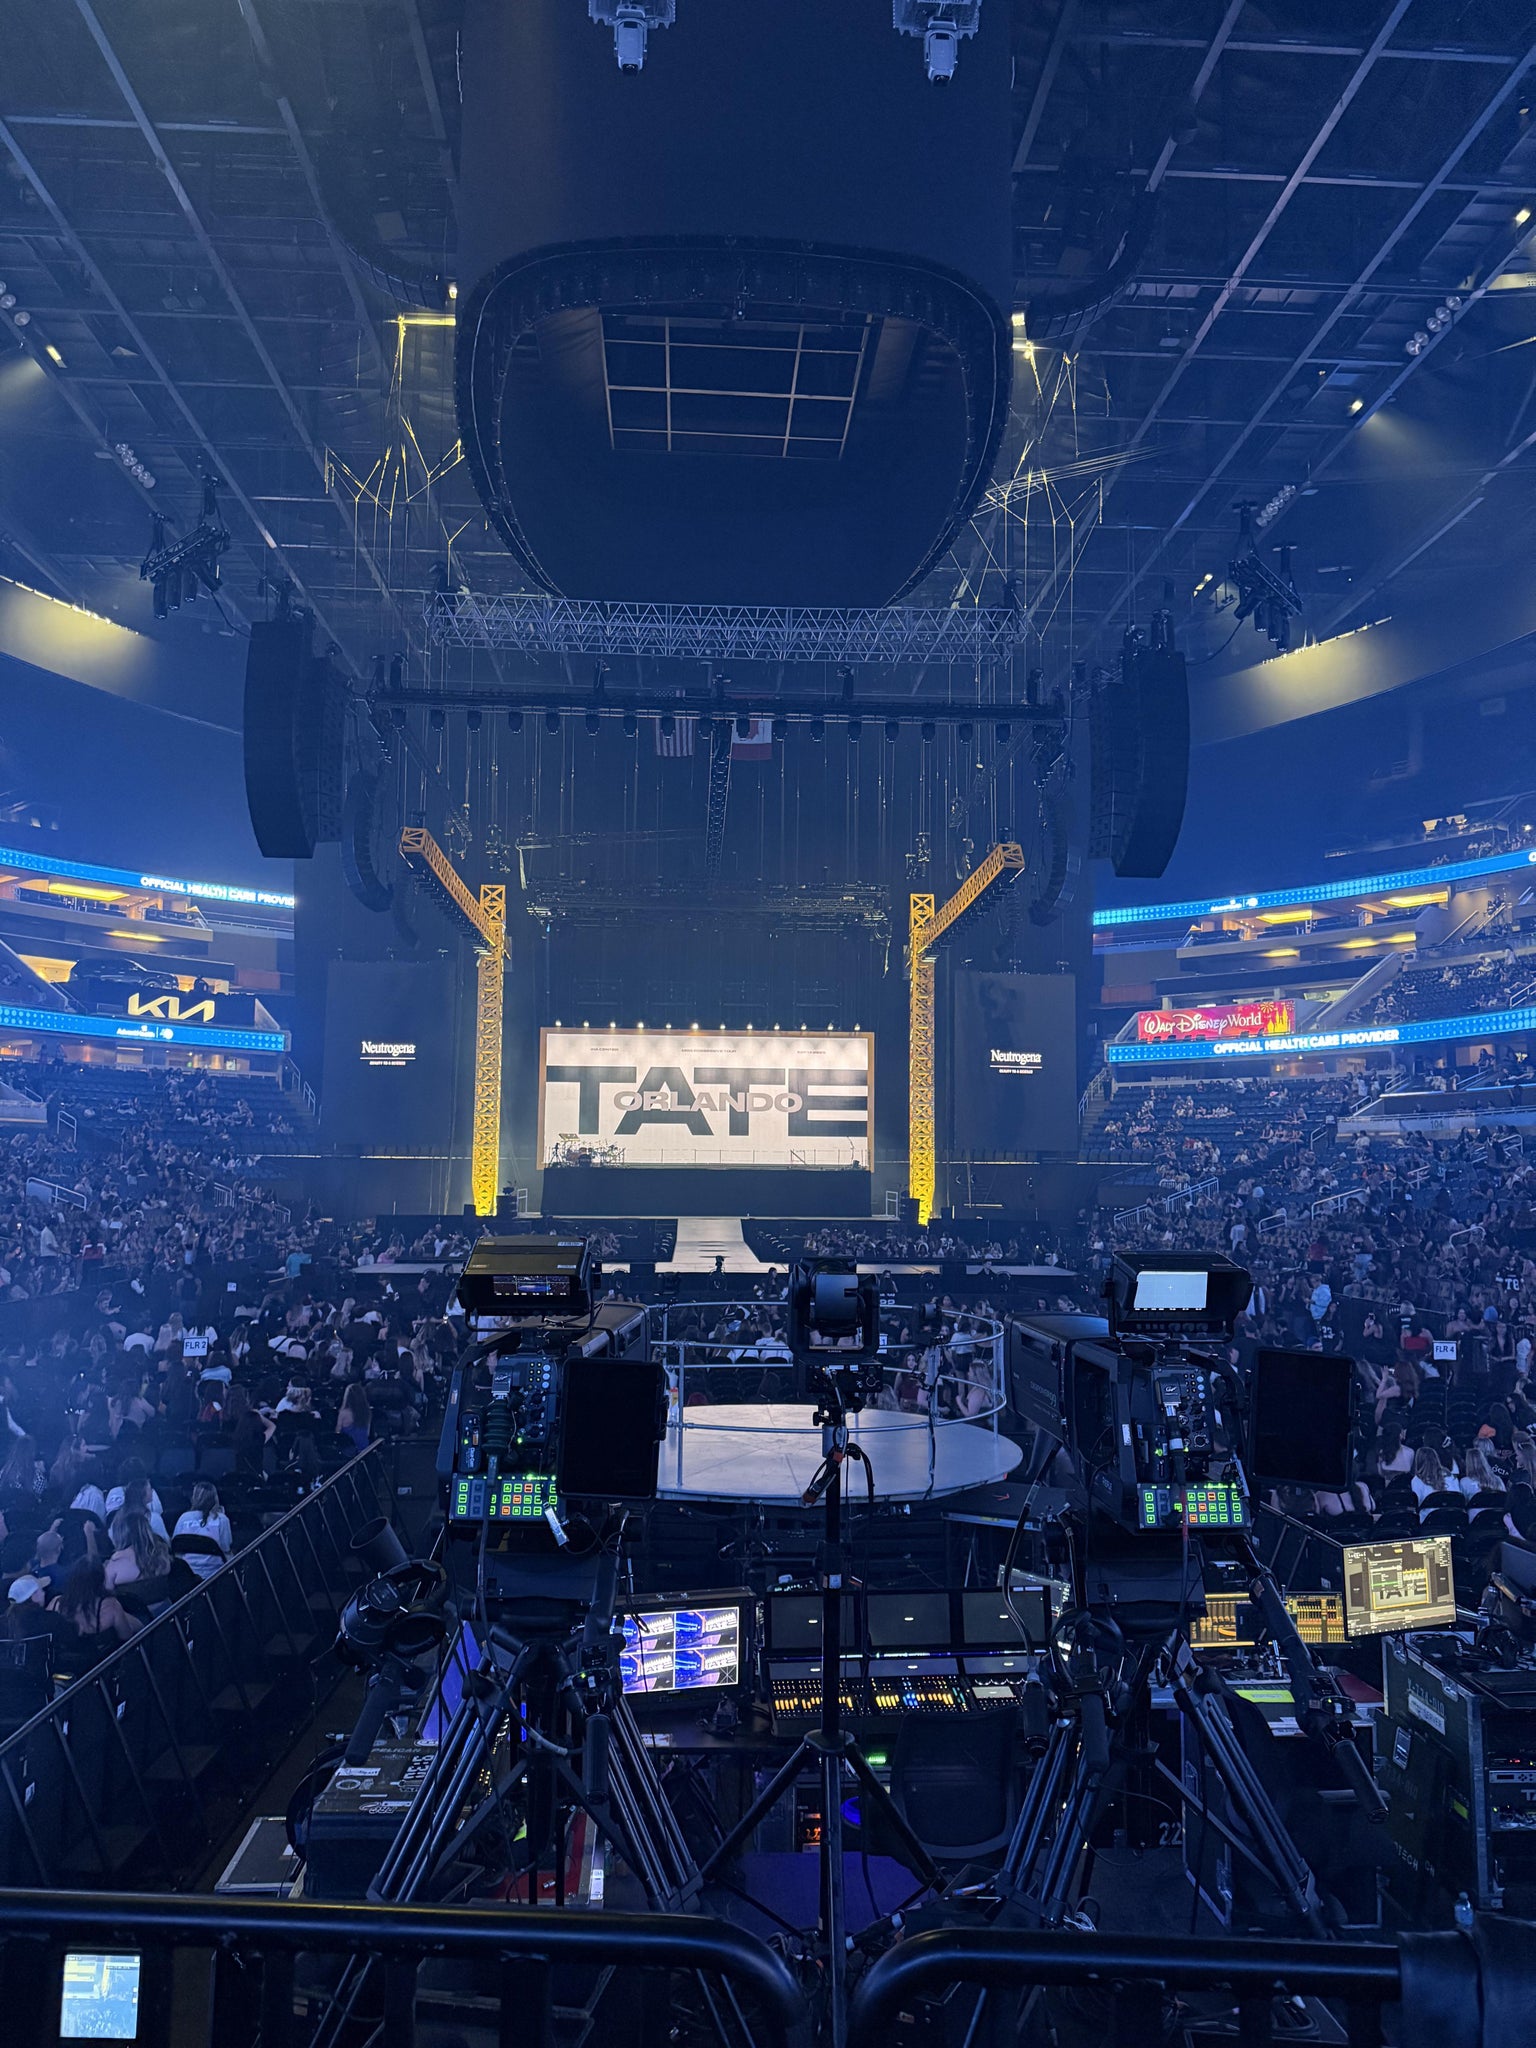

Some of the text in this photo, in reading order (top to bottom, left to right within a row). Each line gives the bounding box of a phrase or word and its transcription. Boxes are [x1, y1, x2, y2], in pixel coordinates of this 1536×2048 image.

[140, 876, 186, 893] OFFICIAL
[187, 883, 228, 898] HEALTH
[361, 1040, 416, 1056] Neutrogena
[1213, 1029, 1400, 1055] OFFICIAL HEALTH CARE PROVIDER
[990, 1049, 1042, 1065] Neutrogena
[546, 1065, 868, 1138] TATE
[613, 1091, 803, 1113] ORLANDO
[185, 1341, 207, 1350] FLR 2
[1435, 1345, 1455, 1353] FLR 4
